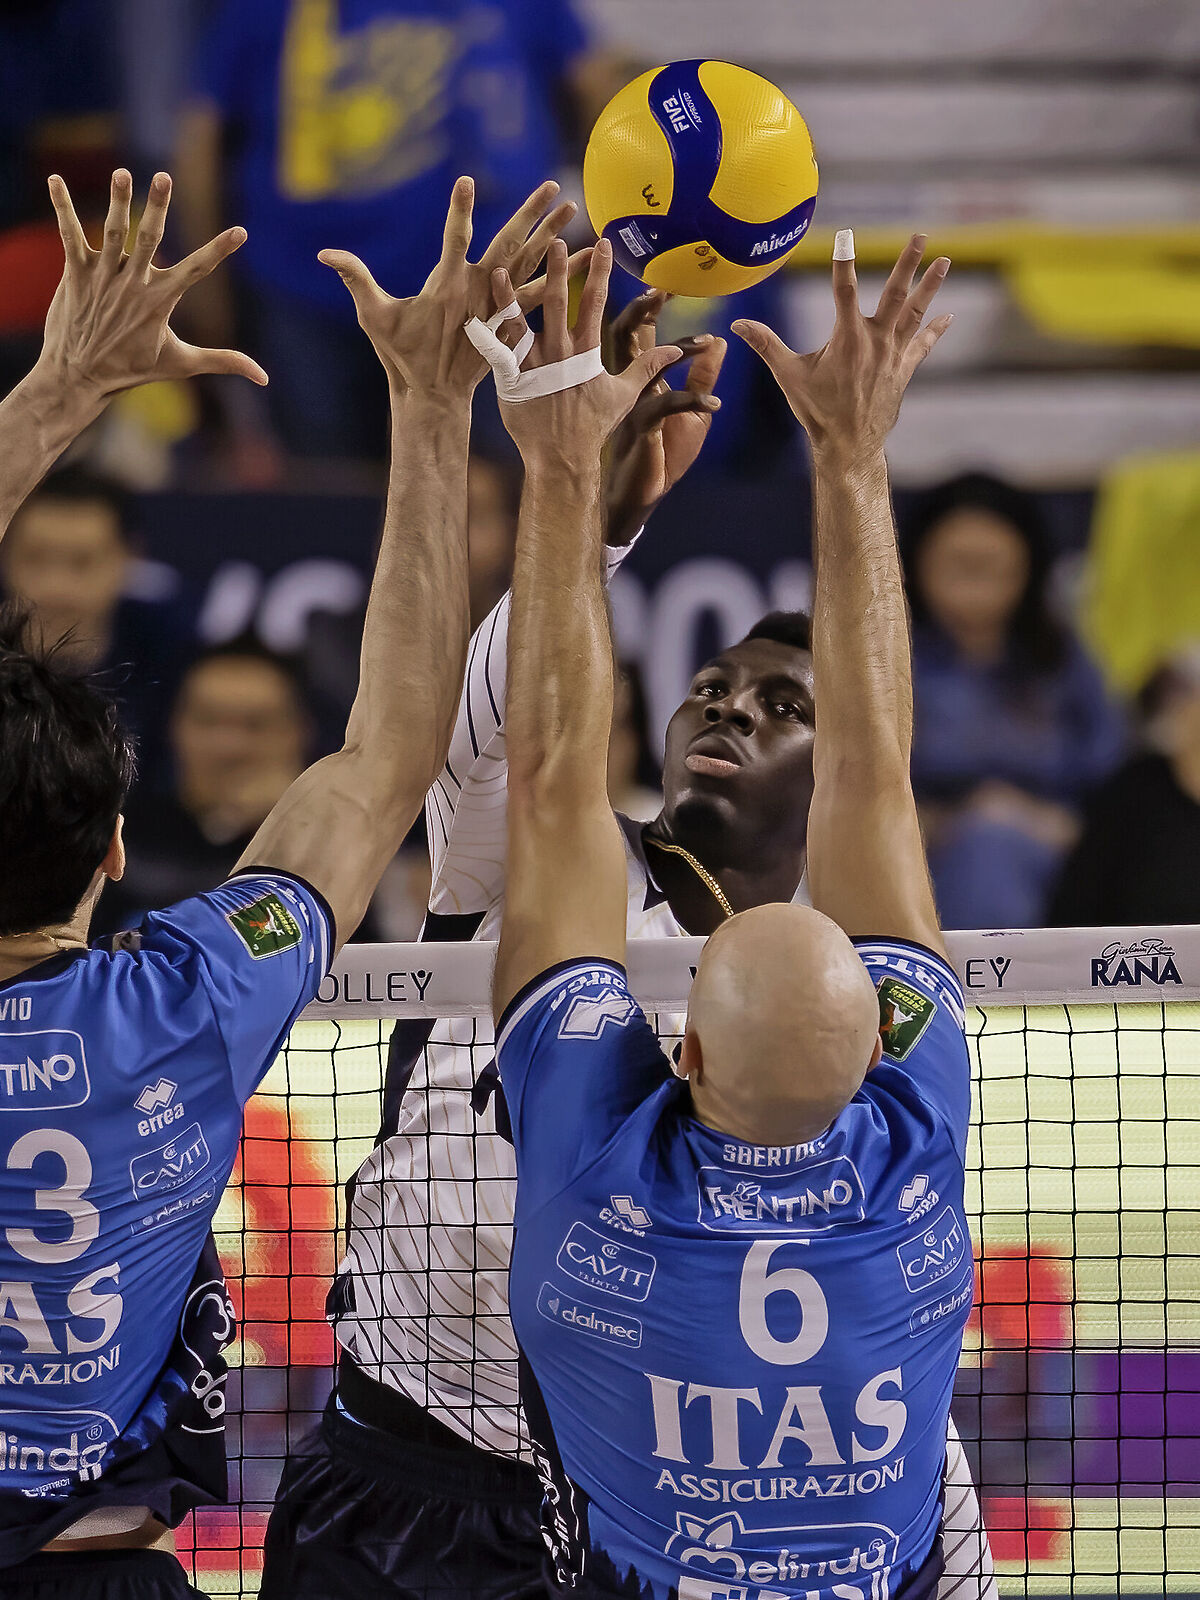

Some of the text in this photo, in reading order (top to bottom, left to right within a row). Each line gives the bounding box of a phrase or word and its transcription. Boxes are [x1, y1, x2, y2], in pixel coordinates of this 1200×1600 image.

[663, 95, 690, 134] FIVB
[315, 969, 433, 1003] OLLEY
[1091, 956, 1183, 987] RANA
[137, 1102, 185, 1137] errea
[137, 1138, 202, 1189] CAVIT
[705, 1179, 853, 1223] TRENTINO
[566, 1242, 650, 1287] CAVIT
[906, 1223, 961, 1277] CAVIT
[562, 1306, 639, 1341] dalmec
[738, 1238, 829, 1366] 6
[643, 1366, 908, 1471] ITAS
[654, 1456, 906, 1503] ASSICURAZIONI
